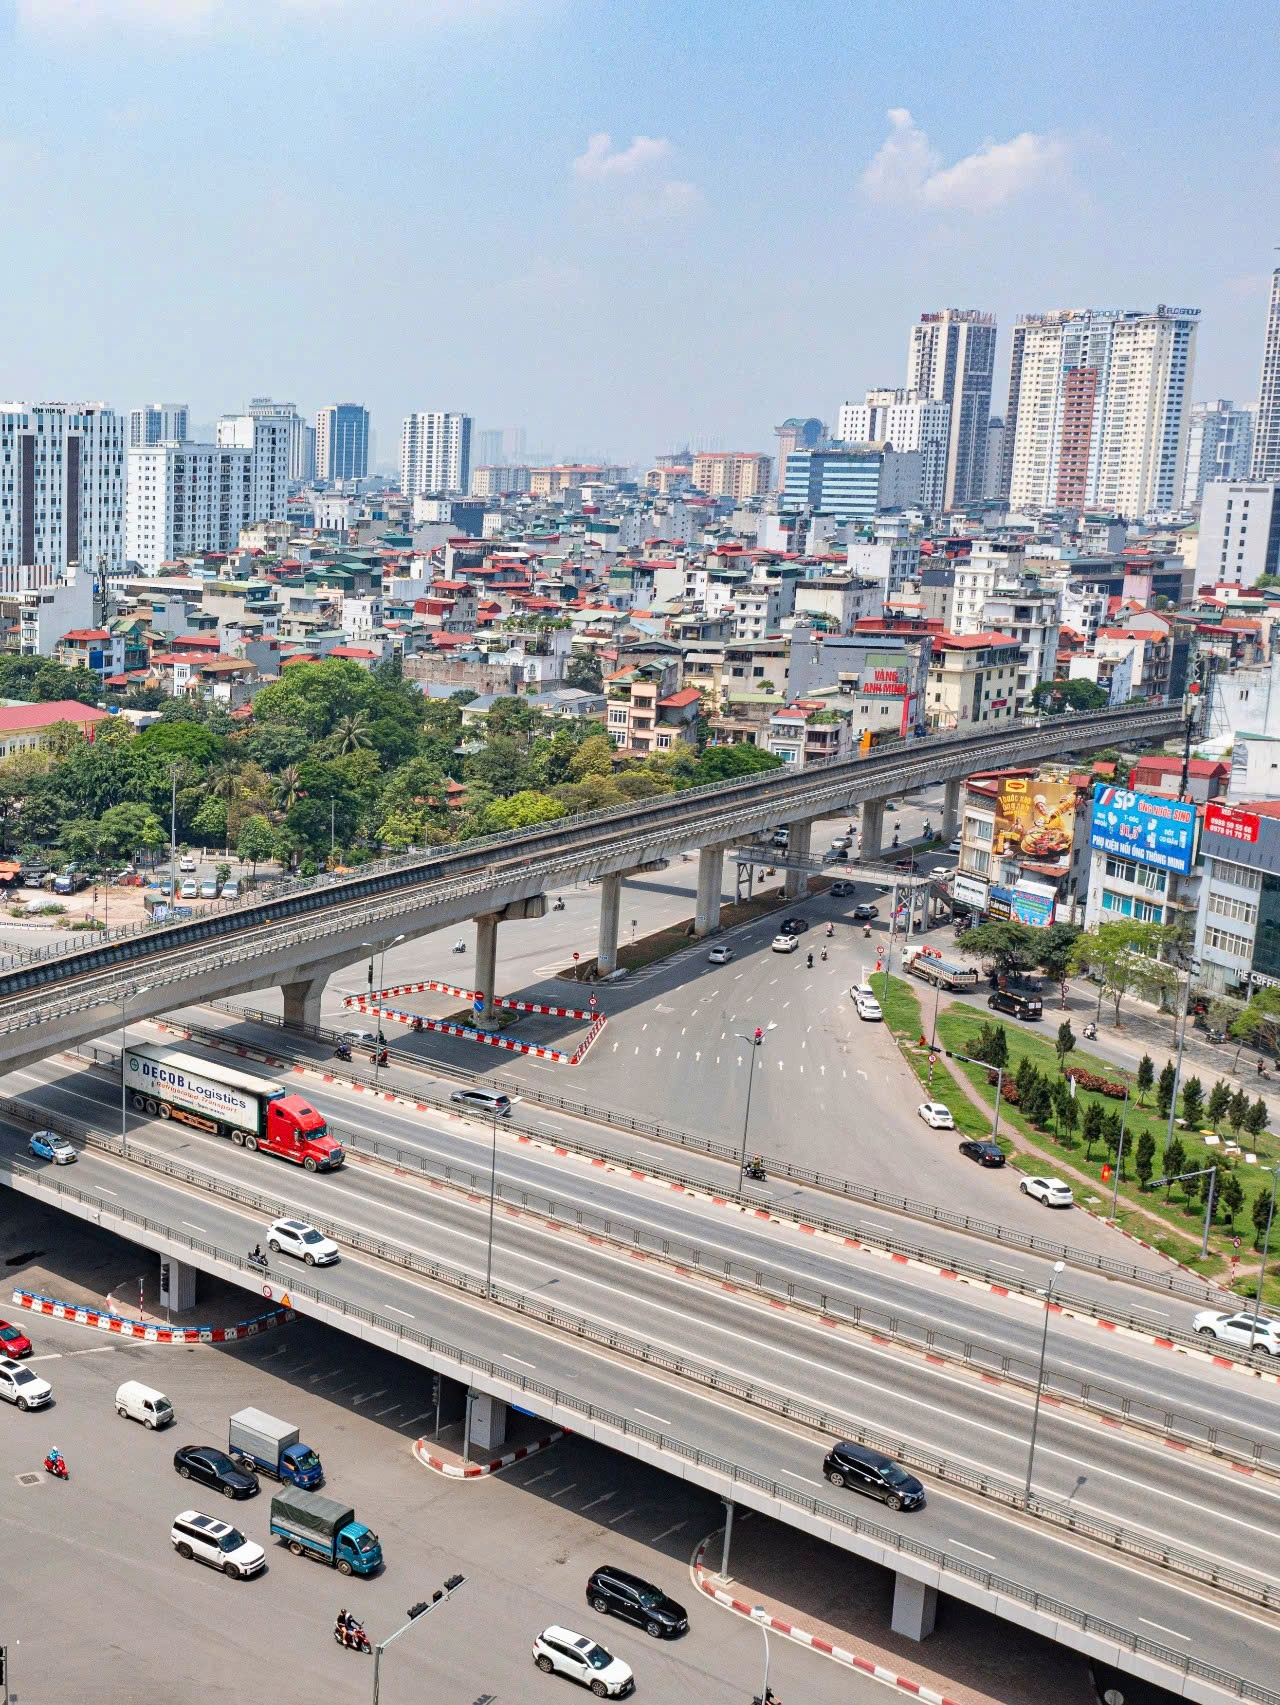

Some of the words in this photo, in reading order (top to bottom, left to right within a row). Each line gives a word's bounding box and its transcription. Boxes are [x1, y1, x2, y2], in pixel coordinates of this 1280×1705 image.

[1113, 790, 1136, 810] SP
[1233, 967, 1249, 981] THE
[188, 1081, 247, 1110] Logistics
